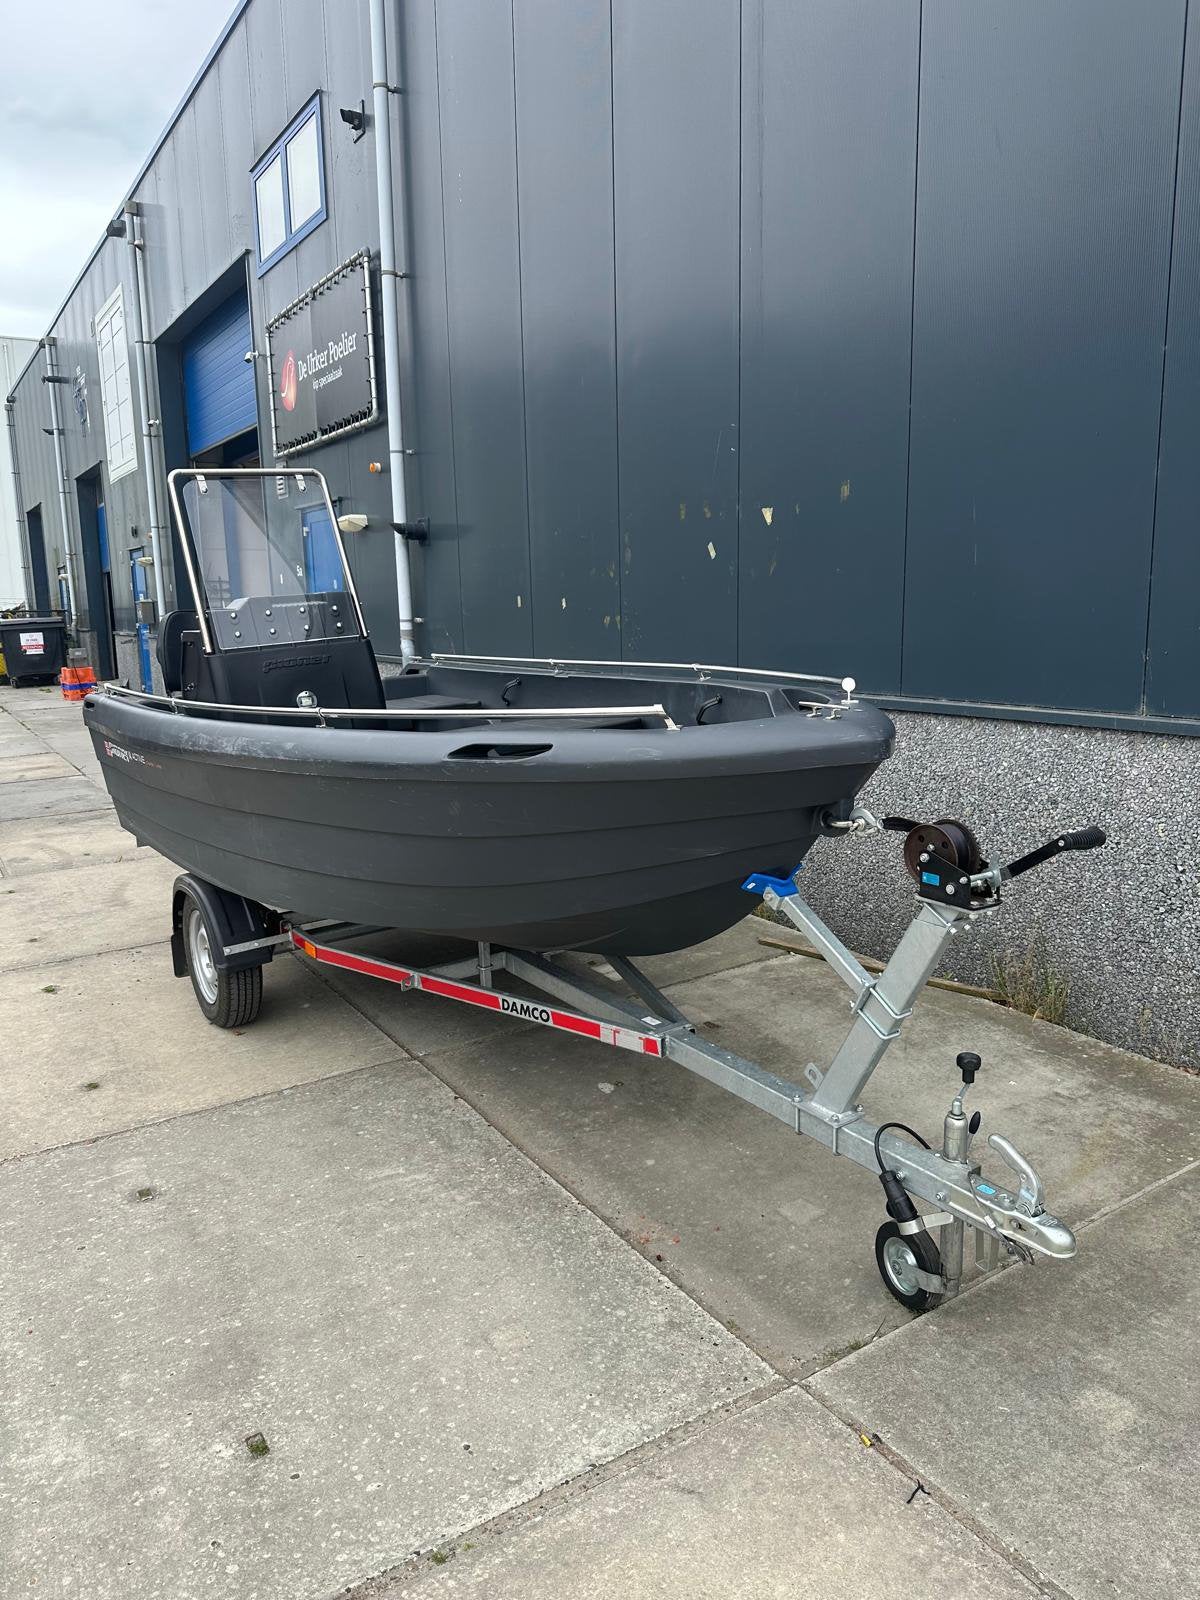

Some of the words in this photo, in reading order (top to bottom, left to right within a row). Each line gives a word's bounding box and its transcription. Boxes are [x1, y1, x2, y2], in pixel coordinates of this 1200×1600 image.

[298, 360, 307, 381] De
[307, 349, 328, 375] Urker
[328, 331, 357, 364] Poelier
[501, 998, 550, 1023] DAMCO
